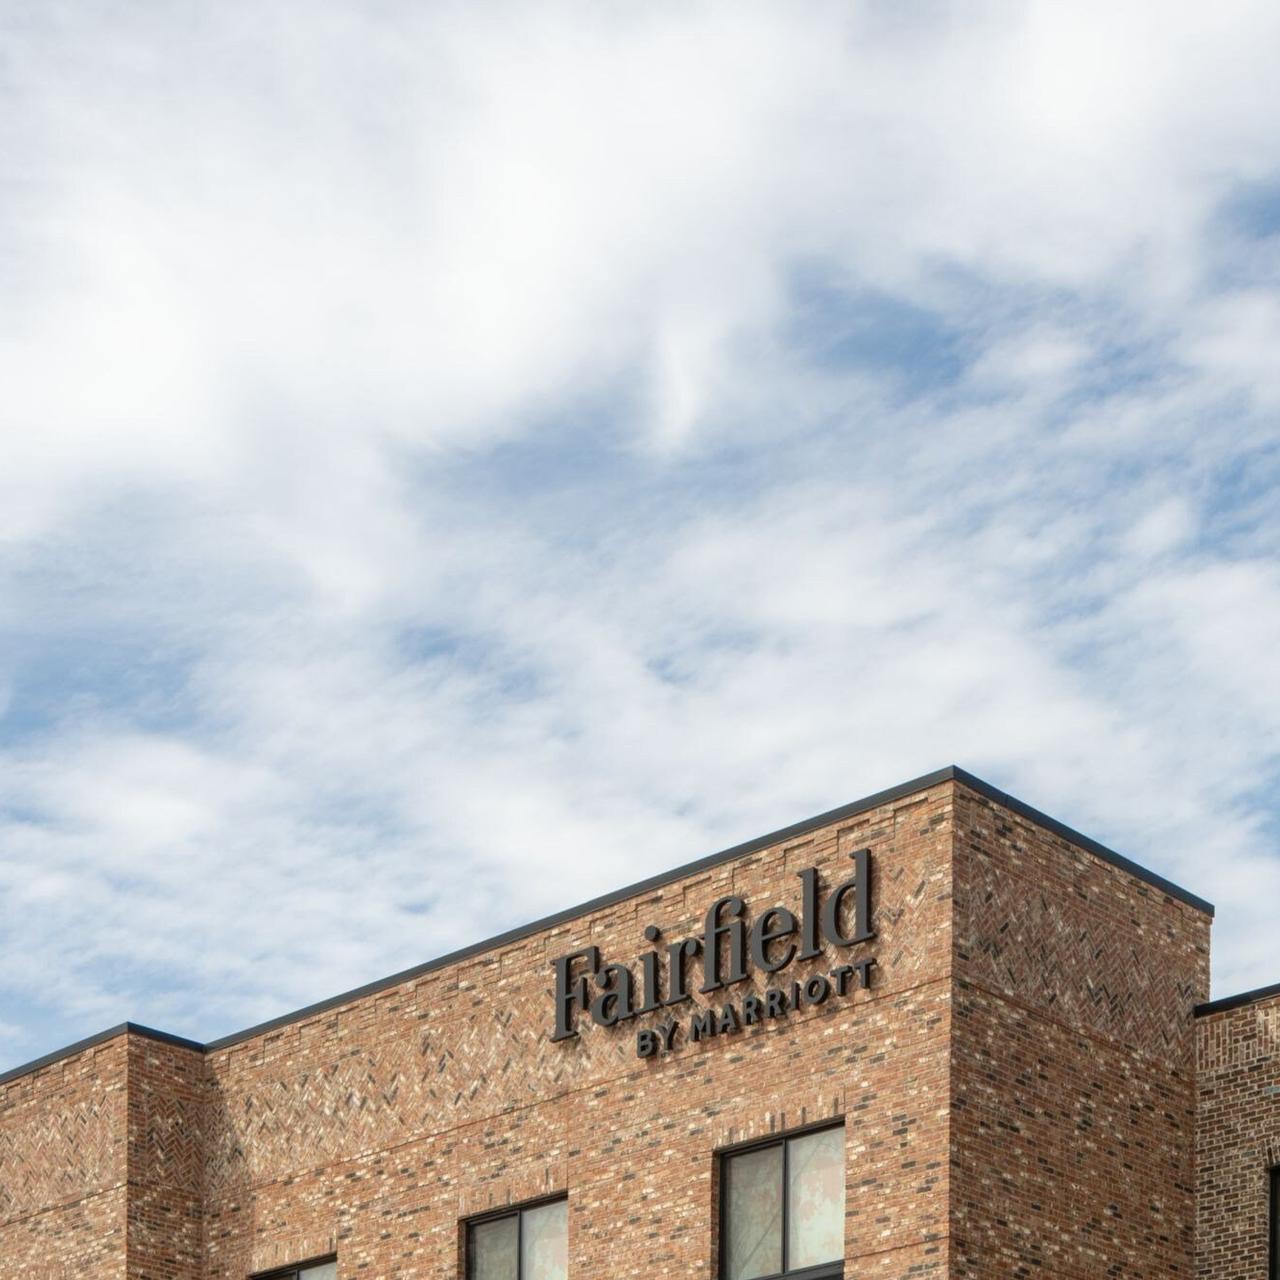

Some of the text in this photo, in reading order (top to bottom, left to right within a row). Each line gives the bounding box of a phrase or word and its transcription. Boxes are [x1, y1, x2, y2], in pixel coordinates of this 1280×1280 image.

[551, 847, 877, 1043] Fairfield
[637, 957, 878, 1058] BY MARRIOTT
